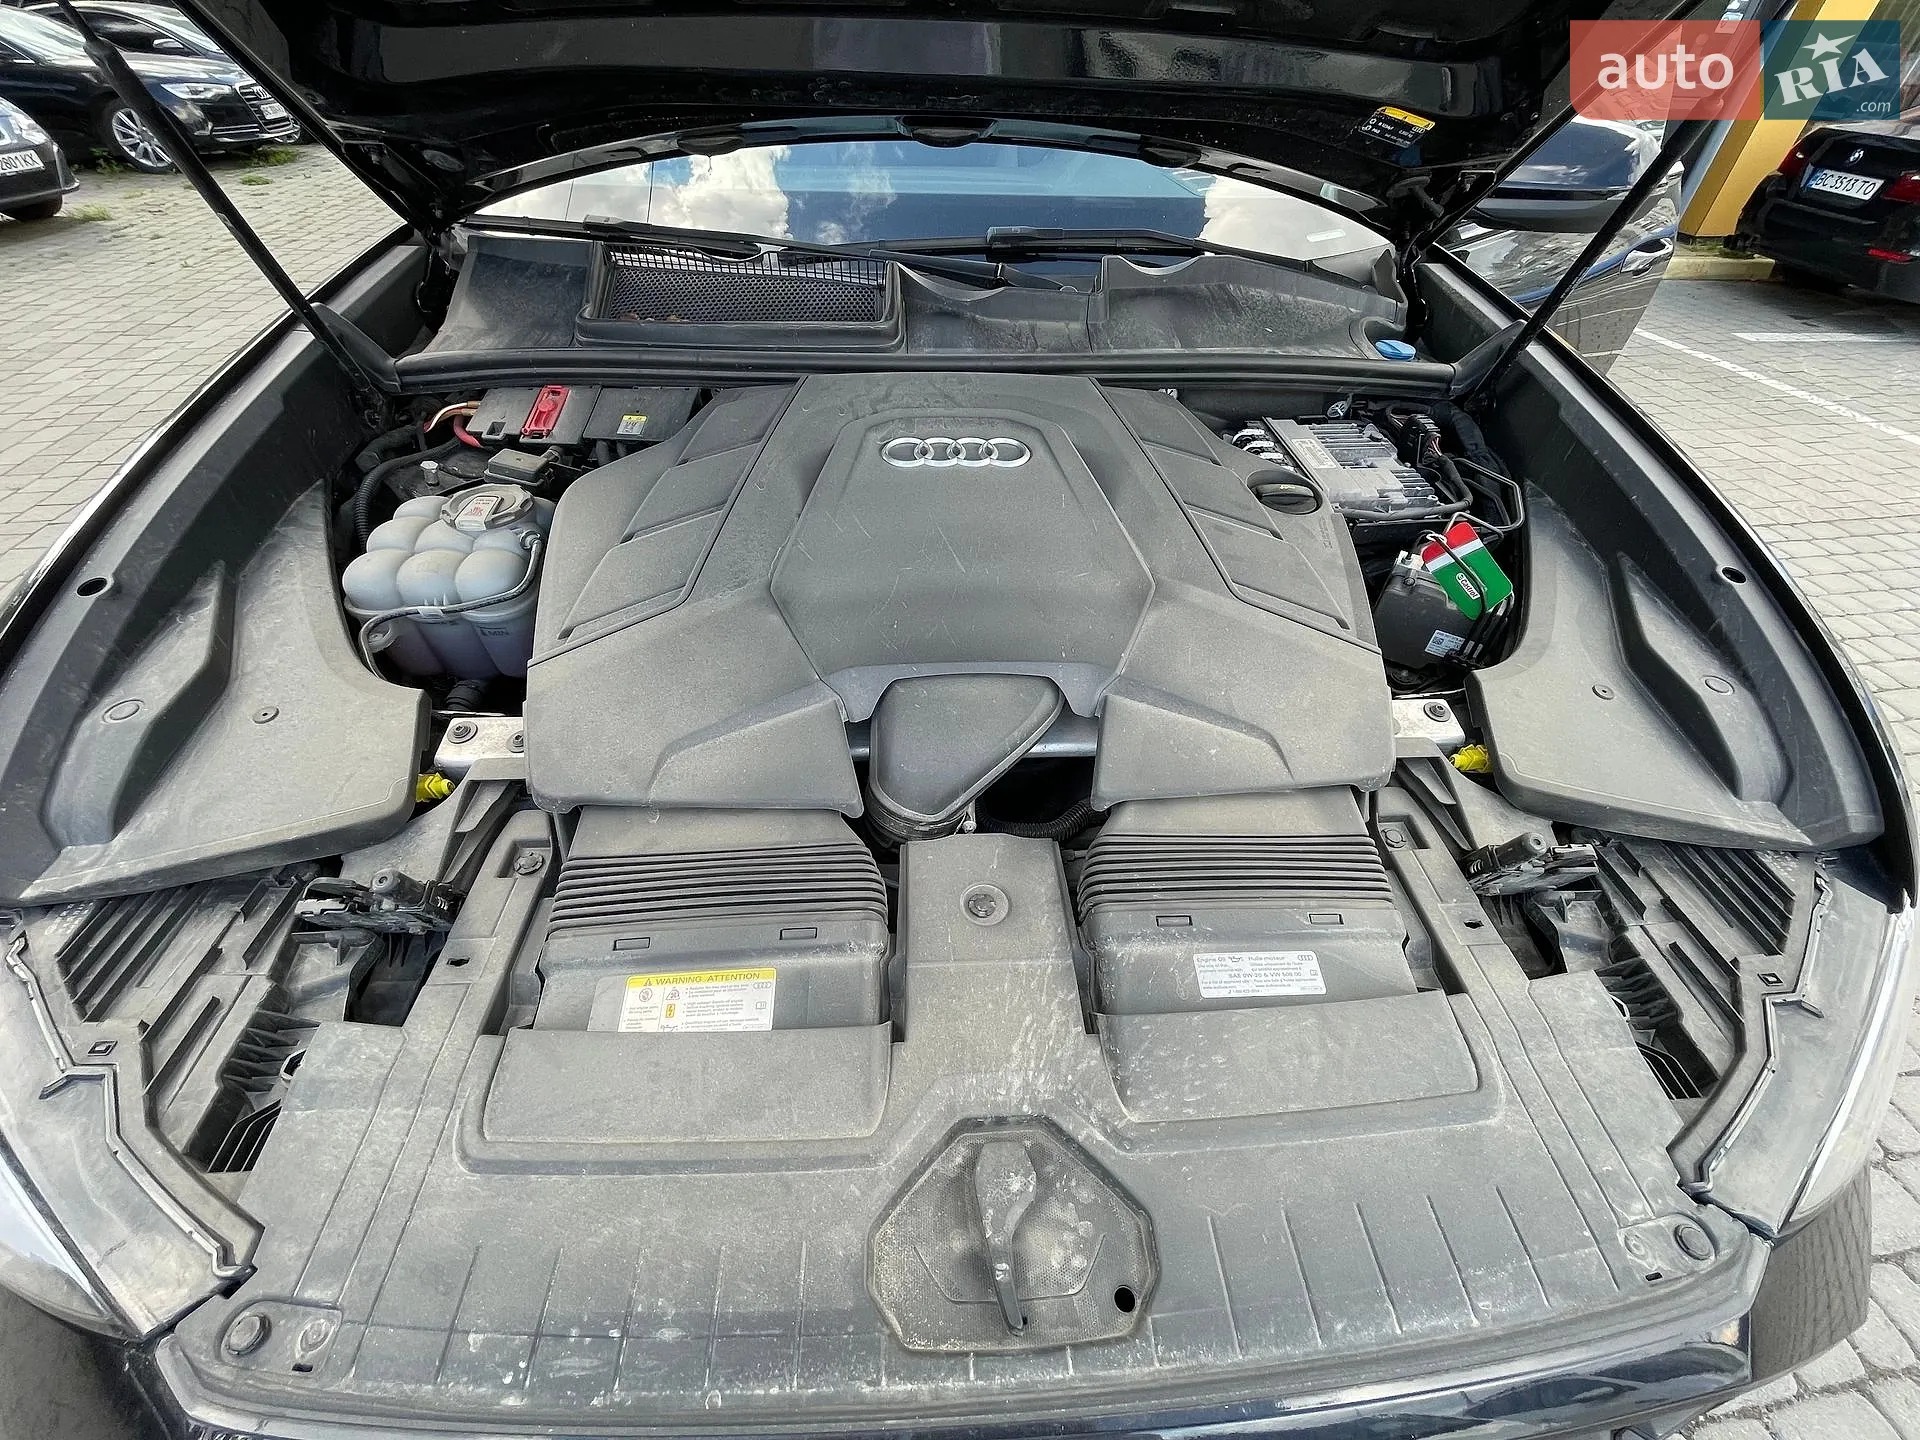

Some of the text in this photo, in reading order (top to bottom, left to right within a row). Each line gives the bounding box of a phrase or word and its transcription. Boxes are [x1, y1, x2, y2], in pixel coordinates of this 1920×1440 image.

[1460, 579, 1479, 598] Castrol
[655, 972, 761, 986] WARNING ATTENTION
